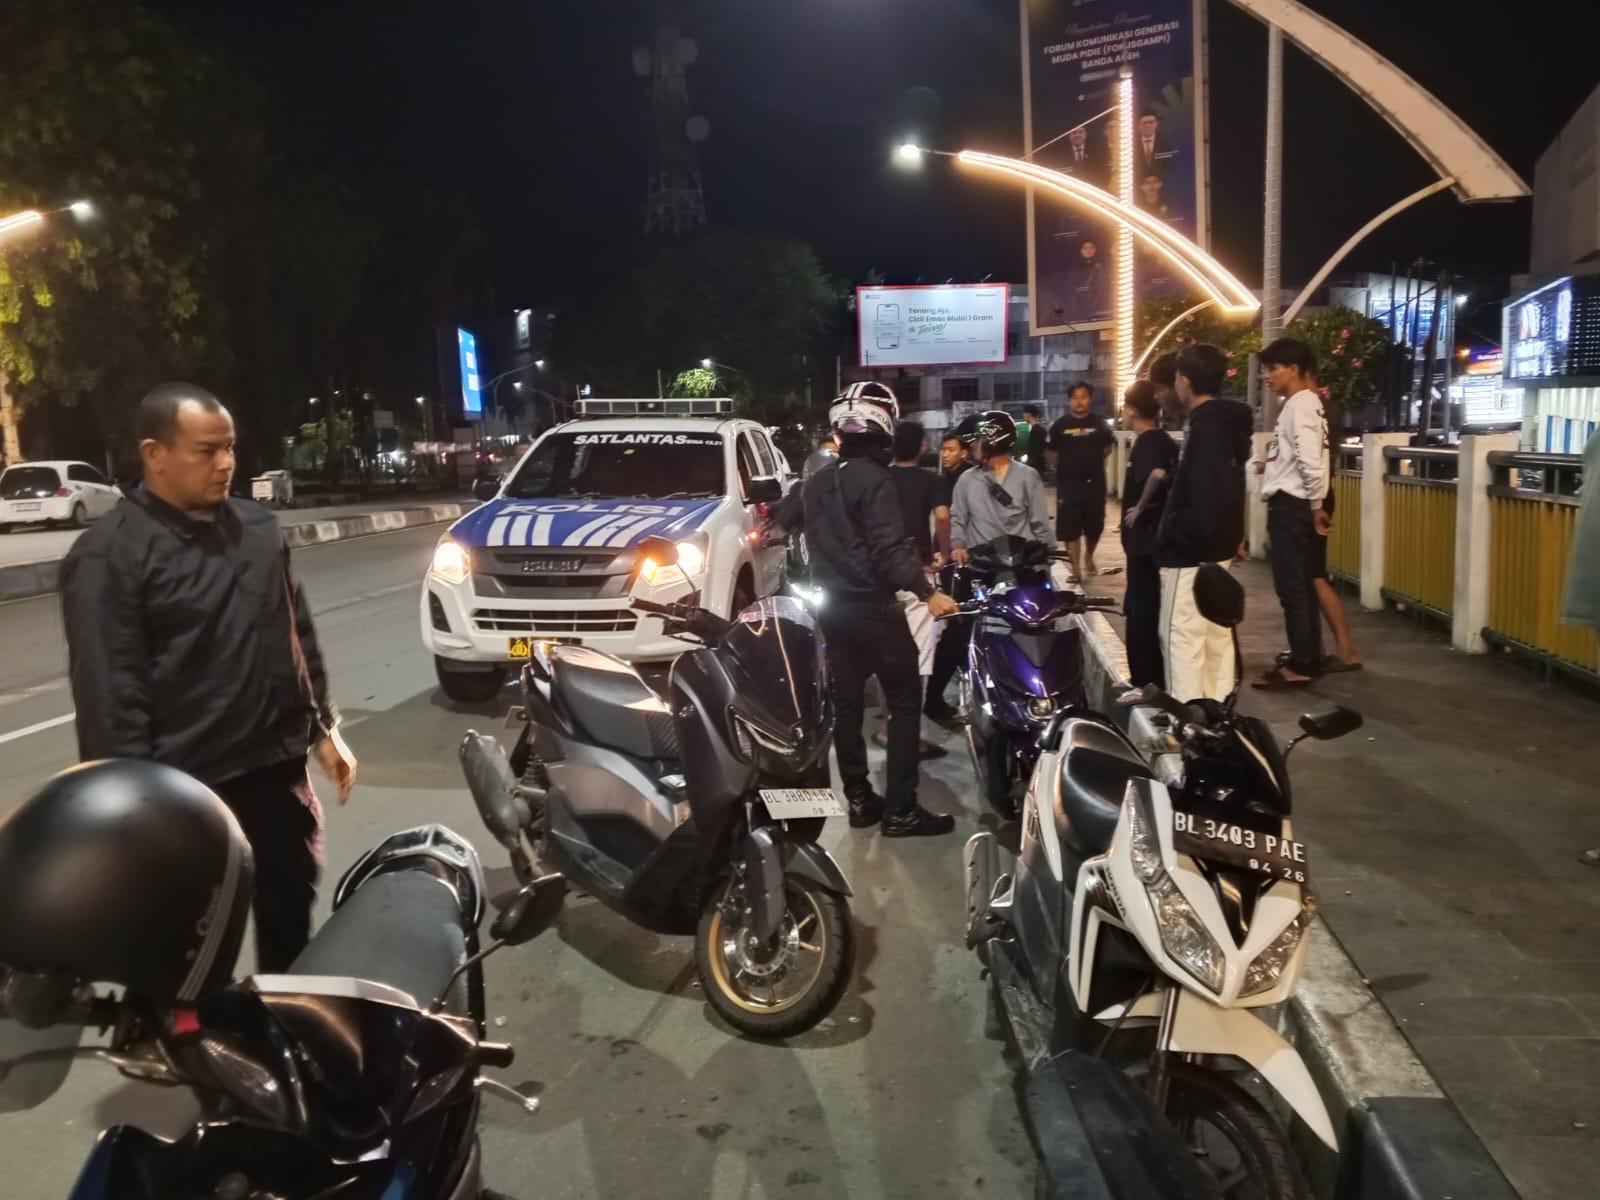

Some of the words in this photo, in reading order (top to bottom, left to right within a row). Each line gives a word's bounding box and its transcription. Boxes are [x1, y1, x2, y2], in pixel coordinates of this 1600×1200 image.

[1044, 41, 1075, 55] FORUM
[1076, 30, 1133, 48] KOMUNIKASI
[1135, 20, 1179, 37] GENERASI
[1051, 53, 1078, 64] MUDA
[1080, 48, 1101, 59] PIDIE
[1082, 57, 1113, 69] BANDA
[573, 434, 687, 445] SATLANTAS
[499, 503, 683, 516] POLISI
[763, 791, 781, 803] BL
[1175, 811, 1200, 835] BL
[1204, 819, 1256, 849] 3403
[1265, 835, 1306, 863] PAE
[1283, 867, 1306, 883] 26
